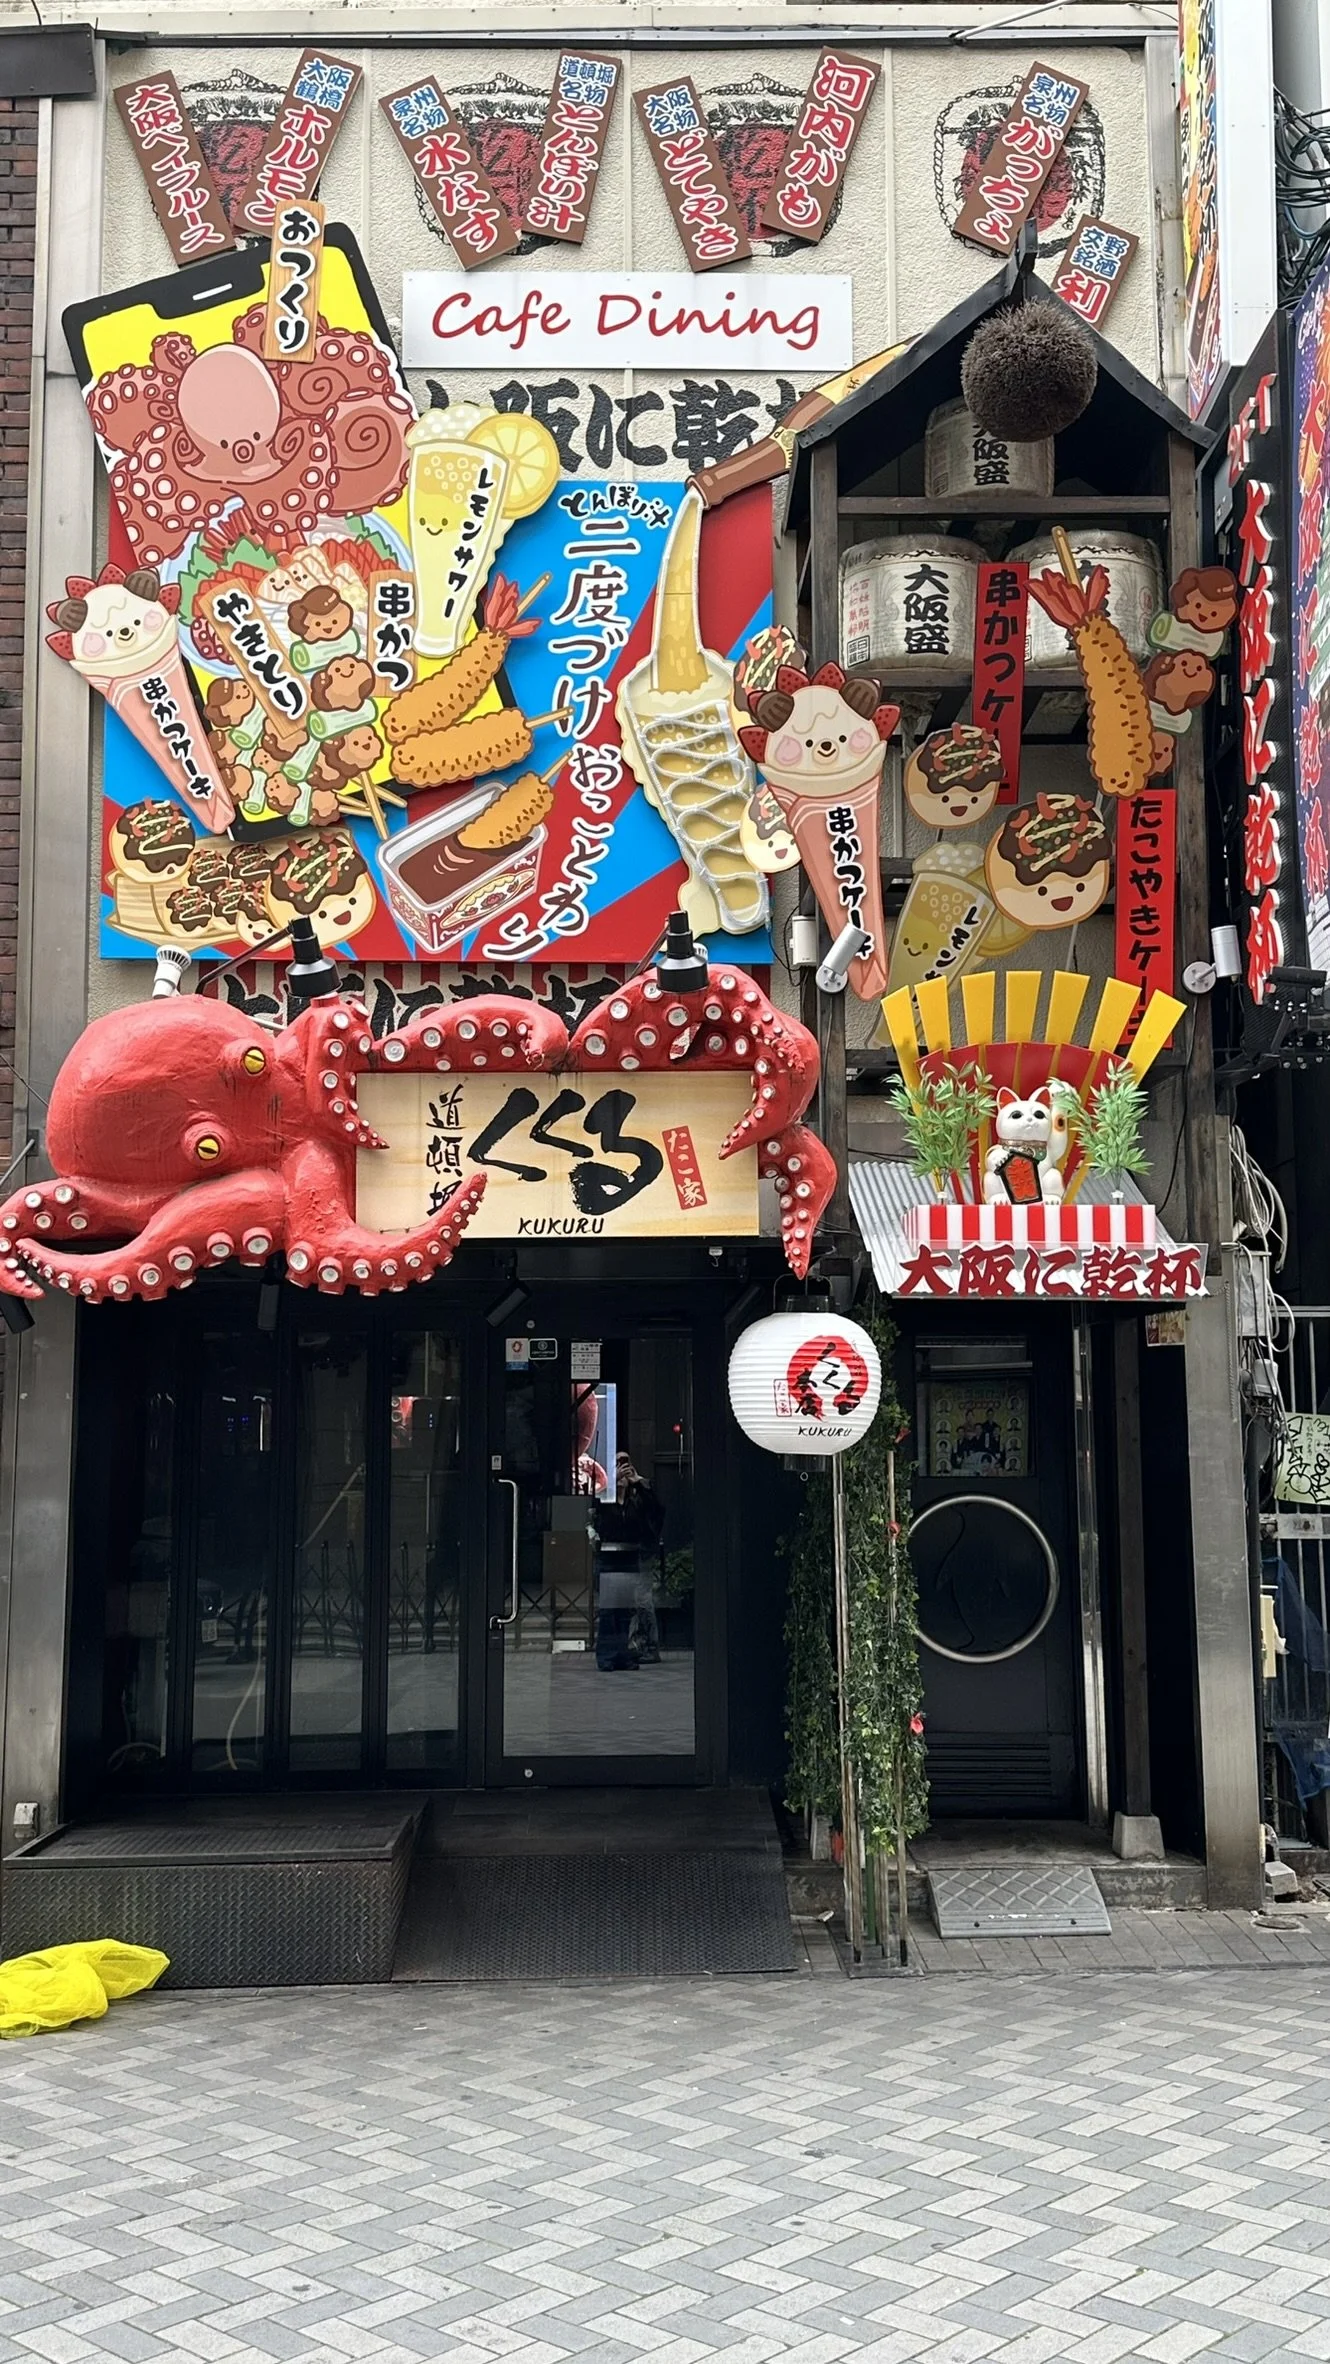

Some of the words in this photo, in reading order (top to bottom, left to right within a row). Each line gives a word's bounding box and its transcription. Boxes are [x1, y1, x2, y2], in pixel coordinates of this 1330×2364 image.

[294, 81, 343, 112] 鶴橋
[303, 58, 350, 90] 大阪
[560, 56, 615, 85] 道頓堀
[561, 81, 607, 107] 名物
[1032, 73, 1078, 106] 泉州
[393, 86, 439, 119] 泉州
[400, 109, 448, 140] 名物
[645, 86, 691, 115] 大阪
[652, 105, 701, 137] 名物
[1024, 94, 1067, 125] 名物
[126, 83, 224, 252] 大阪ベイブルース
[245, 104, 330, 225] ホルモン
[527, 101, 604, 232] とんぼり汁
[776, 56, 873, 228] 河内がも
[415, 133, 501, 253] 水なす
[662, 129, 739, 260] どてやき
[1070, 245, 1121, 280] 銘酒
[1080, 226, 1129, 257] 交野
[279, 206, 321, 354] おつくり
[432, 291, 570, 349] Cafe
[597, 292, 820, 350] Dining
[424, 378, 811, 472] 阪に乾
[444, 468, 494, 617] レモンサワー
[376, 581, 416, 688] 串かつ
[903, 564, 949, 655] 大阪盛
[215, 590, 307, 717] やきとり
[140, 677, 214, 799] 串かつケーキ
[467, 1087, 664, 1216] くくる
[667, 1130, 705, 1207] たこ家
[517, 1217, 605, 1236] KUKURU
[898, 1243, 1202, 1298] 大阪に乾杯
[798, 1426, 852, 1437] KUKURU
